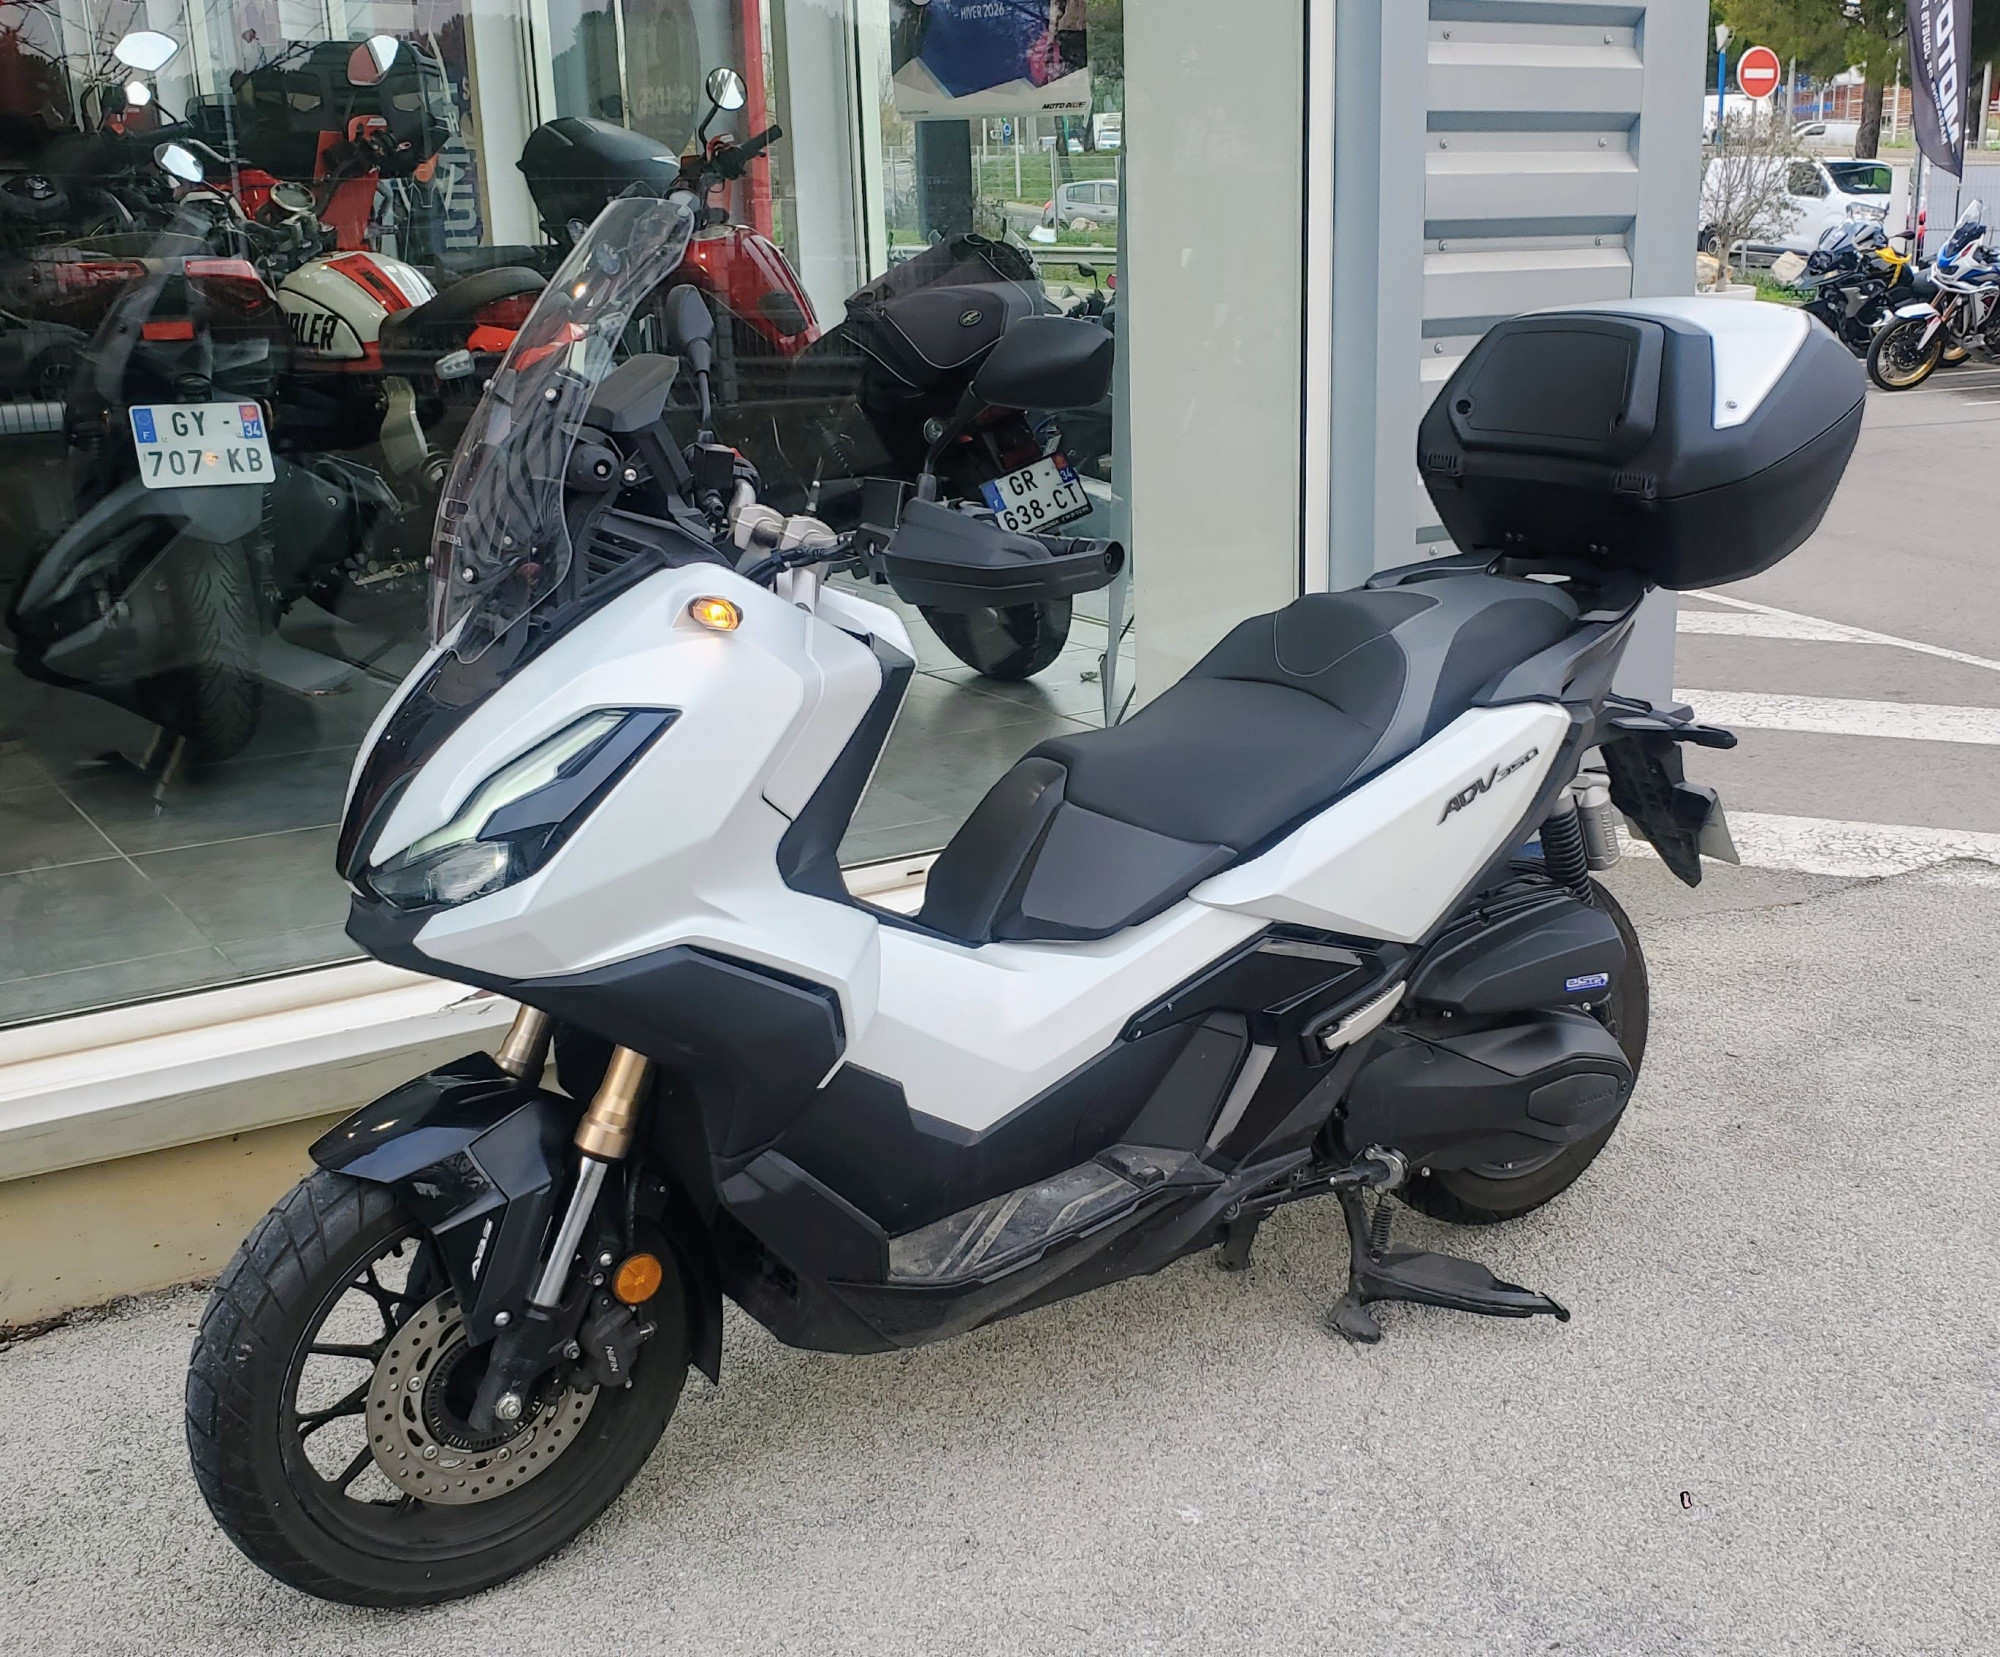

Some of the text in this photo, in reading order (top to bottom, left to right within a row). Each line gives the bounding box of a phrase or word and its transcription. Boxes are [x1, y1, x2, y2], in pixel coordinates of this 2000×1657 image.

[960, 6, 982, 20] HIVER
[983, 2, 1004, 17] 2026
[243, 422, 261, 437] 34
